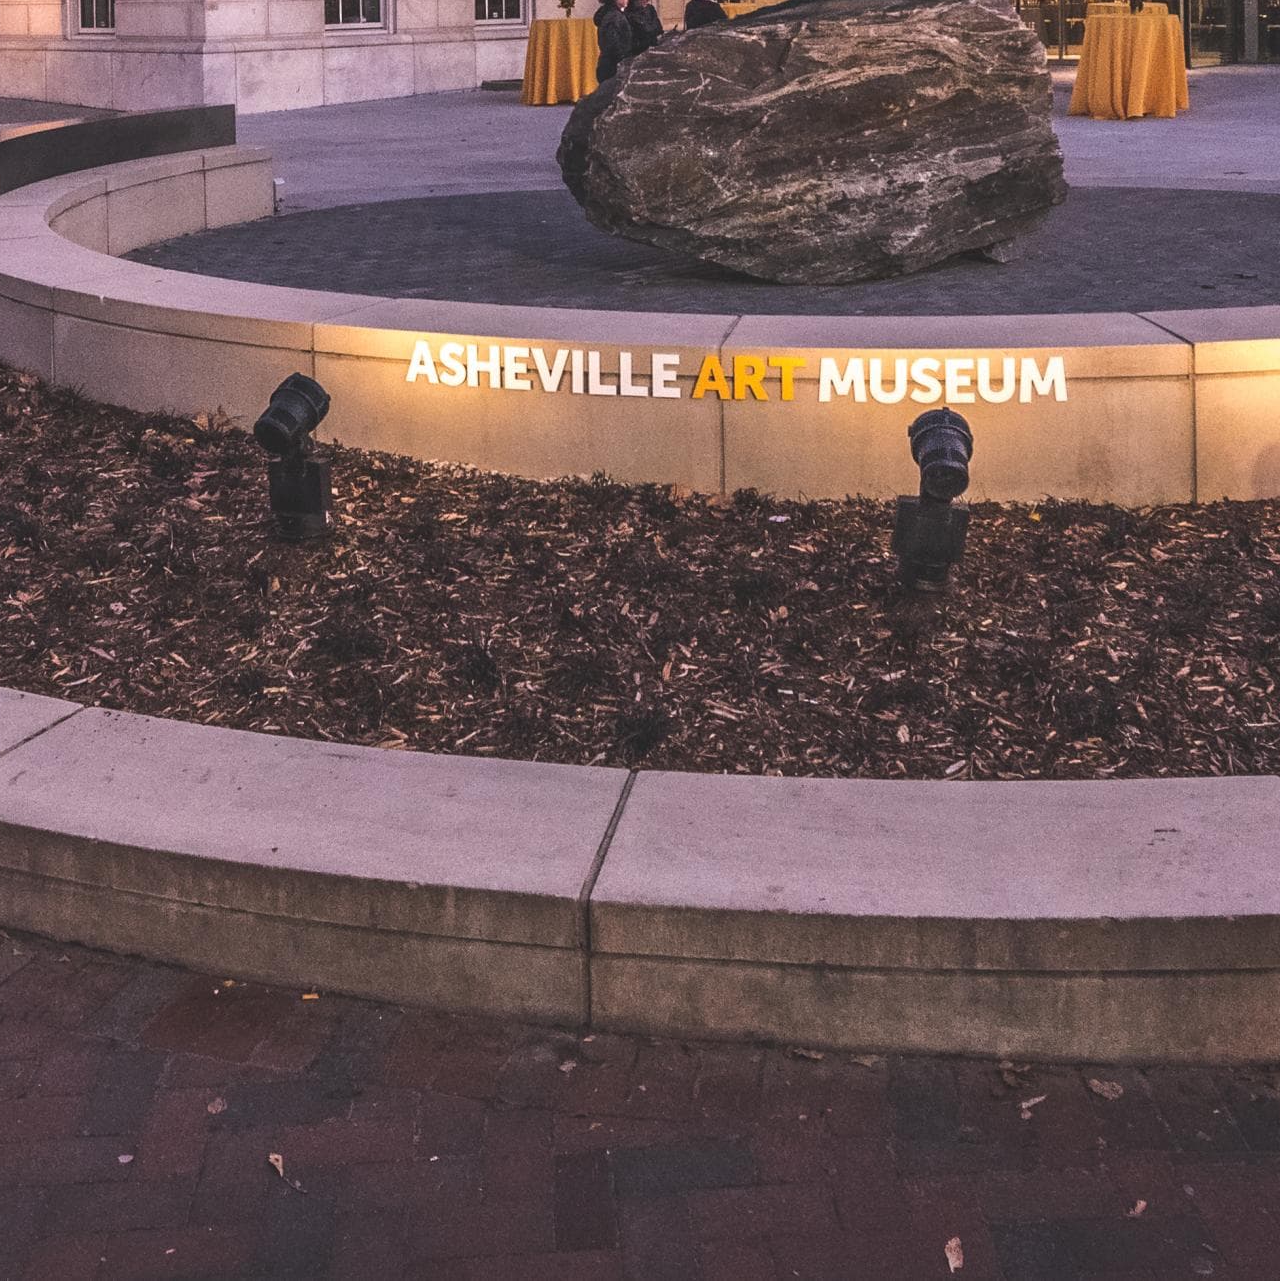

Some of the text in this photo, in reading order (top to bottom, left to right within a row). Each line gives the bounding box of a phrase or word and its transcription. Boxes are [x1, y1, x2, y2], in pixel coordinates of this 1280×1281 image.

[405, 340, 1068, 405] ASHEVILLE ART MUSEUM
